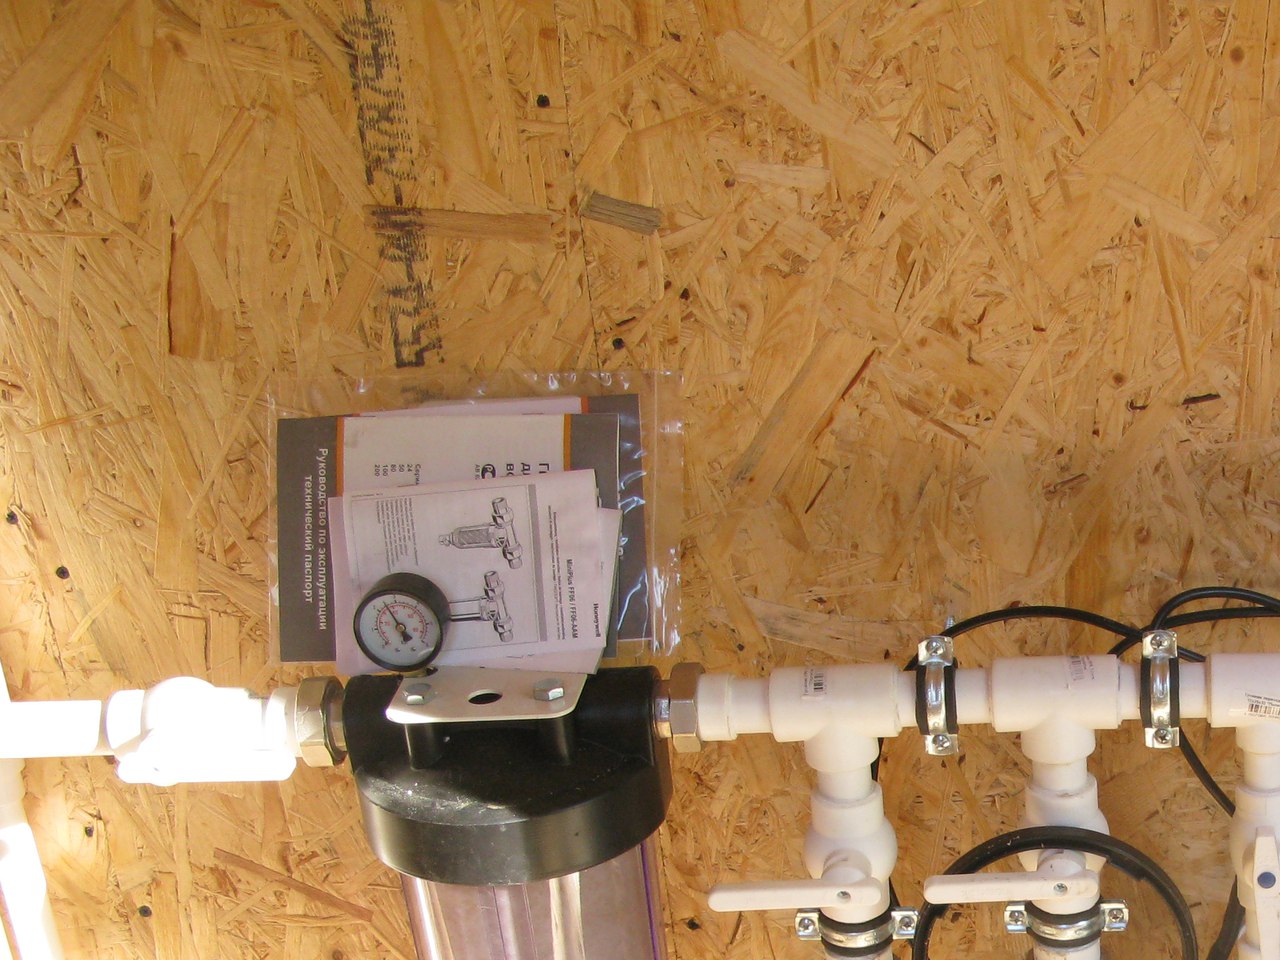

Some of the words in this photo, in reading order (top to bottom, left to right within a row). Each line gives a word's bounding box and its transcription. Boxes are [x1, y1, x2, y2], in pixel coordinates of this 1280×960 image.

[316, 448, 329, 526] Руководство
[304, 474, 315, 551] технический
[318, 529, 327, 544] по
[302, 554, 313, 603] паспорт
[316, 547, 328, 630] эксплуатации
[566, 558, 575, 585] MiniPlus
[568, 587, 576, 602] FF06
[569, 606, 578, 639] FF06-AAM
[593, 603, 601, 638] Honeywell
